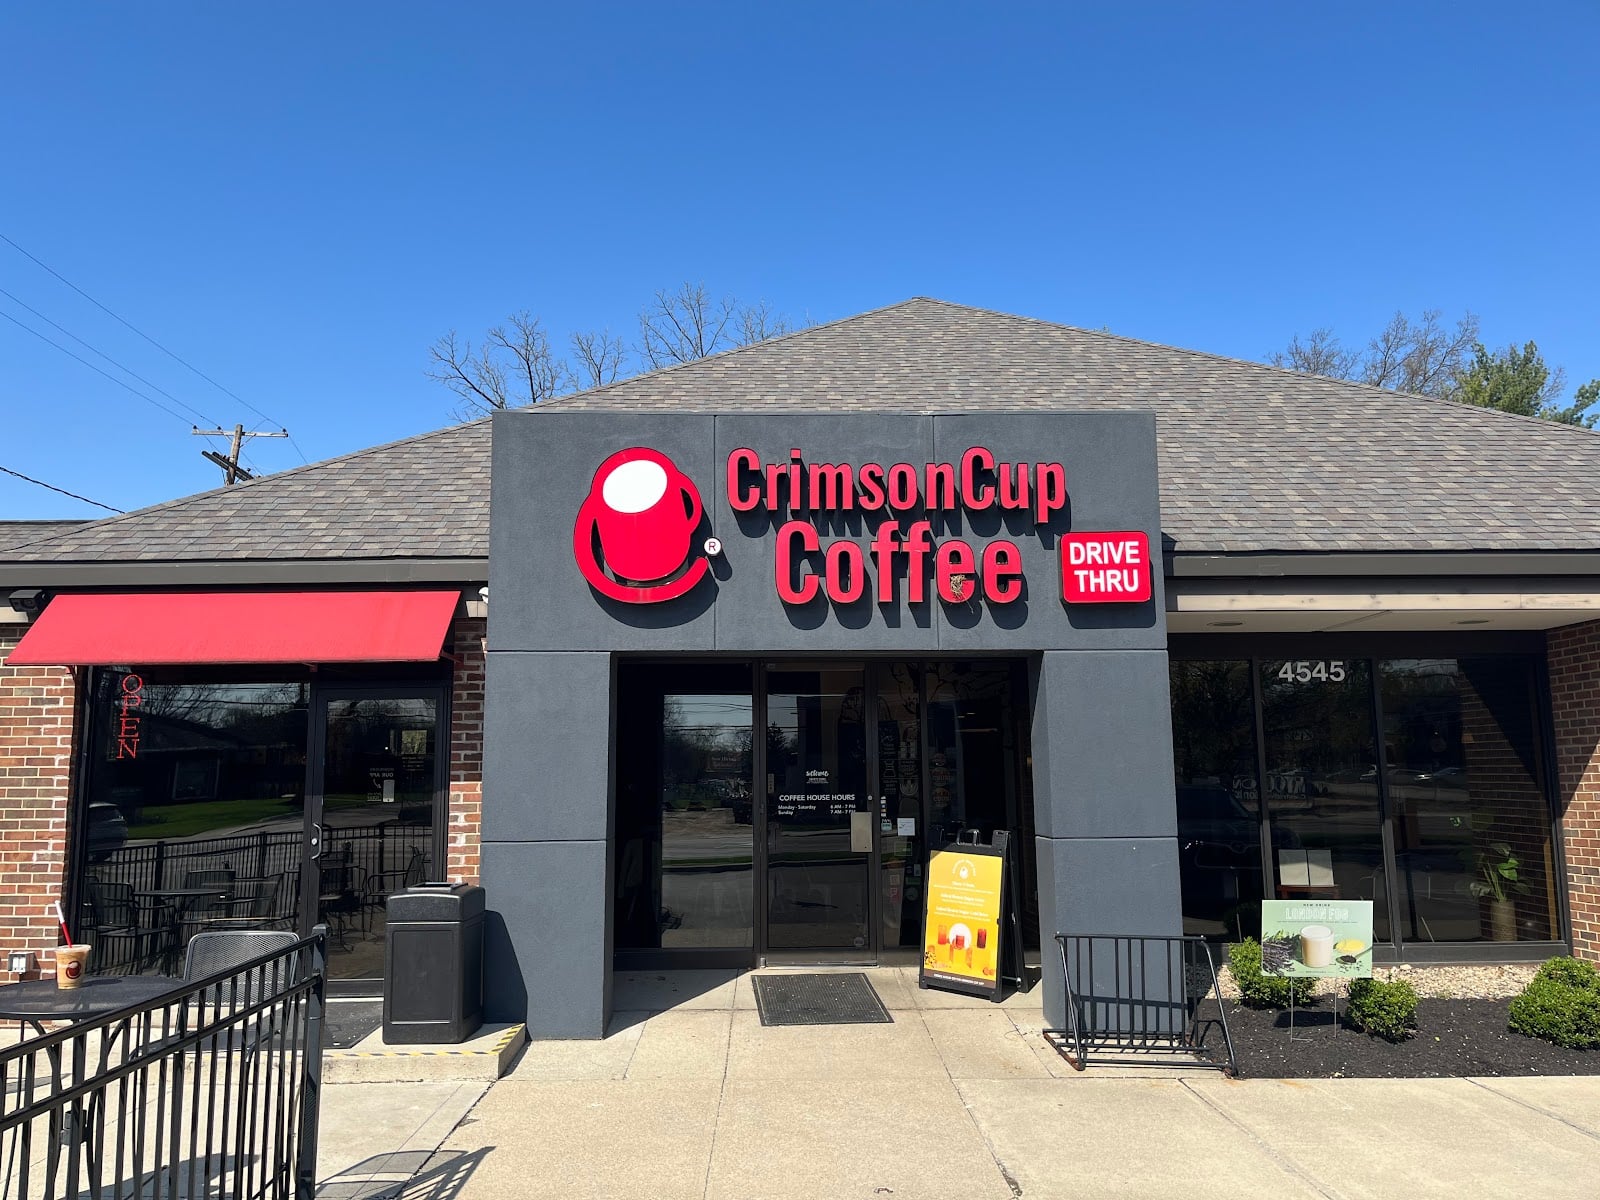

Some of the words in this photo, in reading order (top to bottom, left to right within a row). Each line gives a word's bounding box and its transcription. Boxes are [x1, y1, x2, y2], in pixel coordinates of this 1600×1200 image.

[775, 520, 1022, 605] Coffee
[1069, 541, 1141, 565] DRIVE
[1074, 568, 1139, 593] THRU
[1278, 661, 1346, 682] 4545
[115, 674, 143, 759] OPEN
